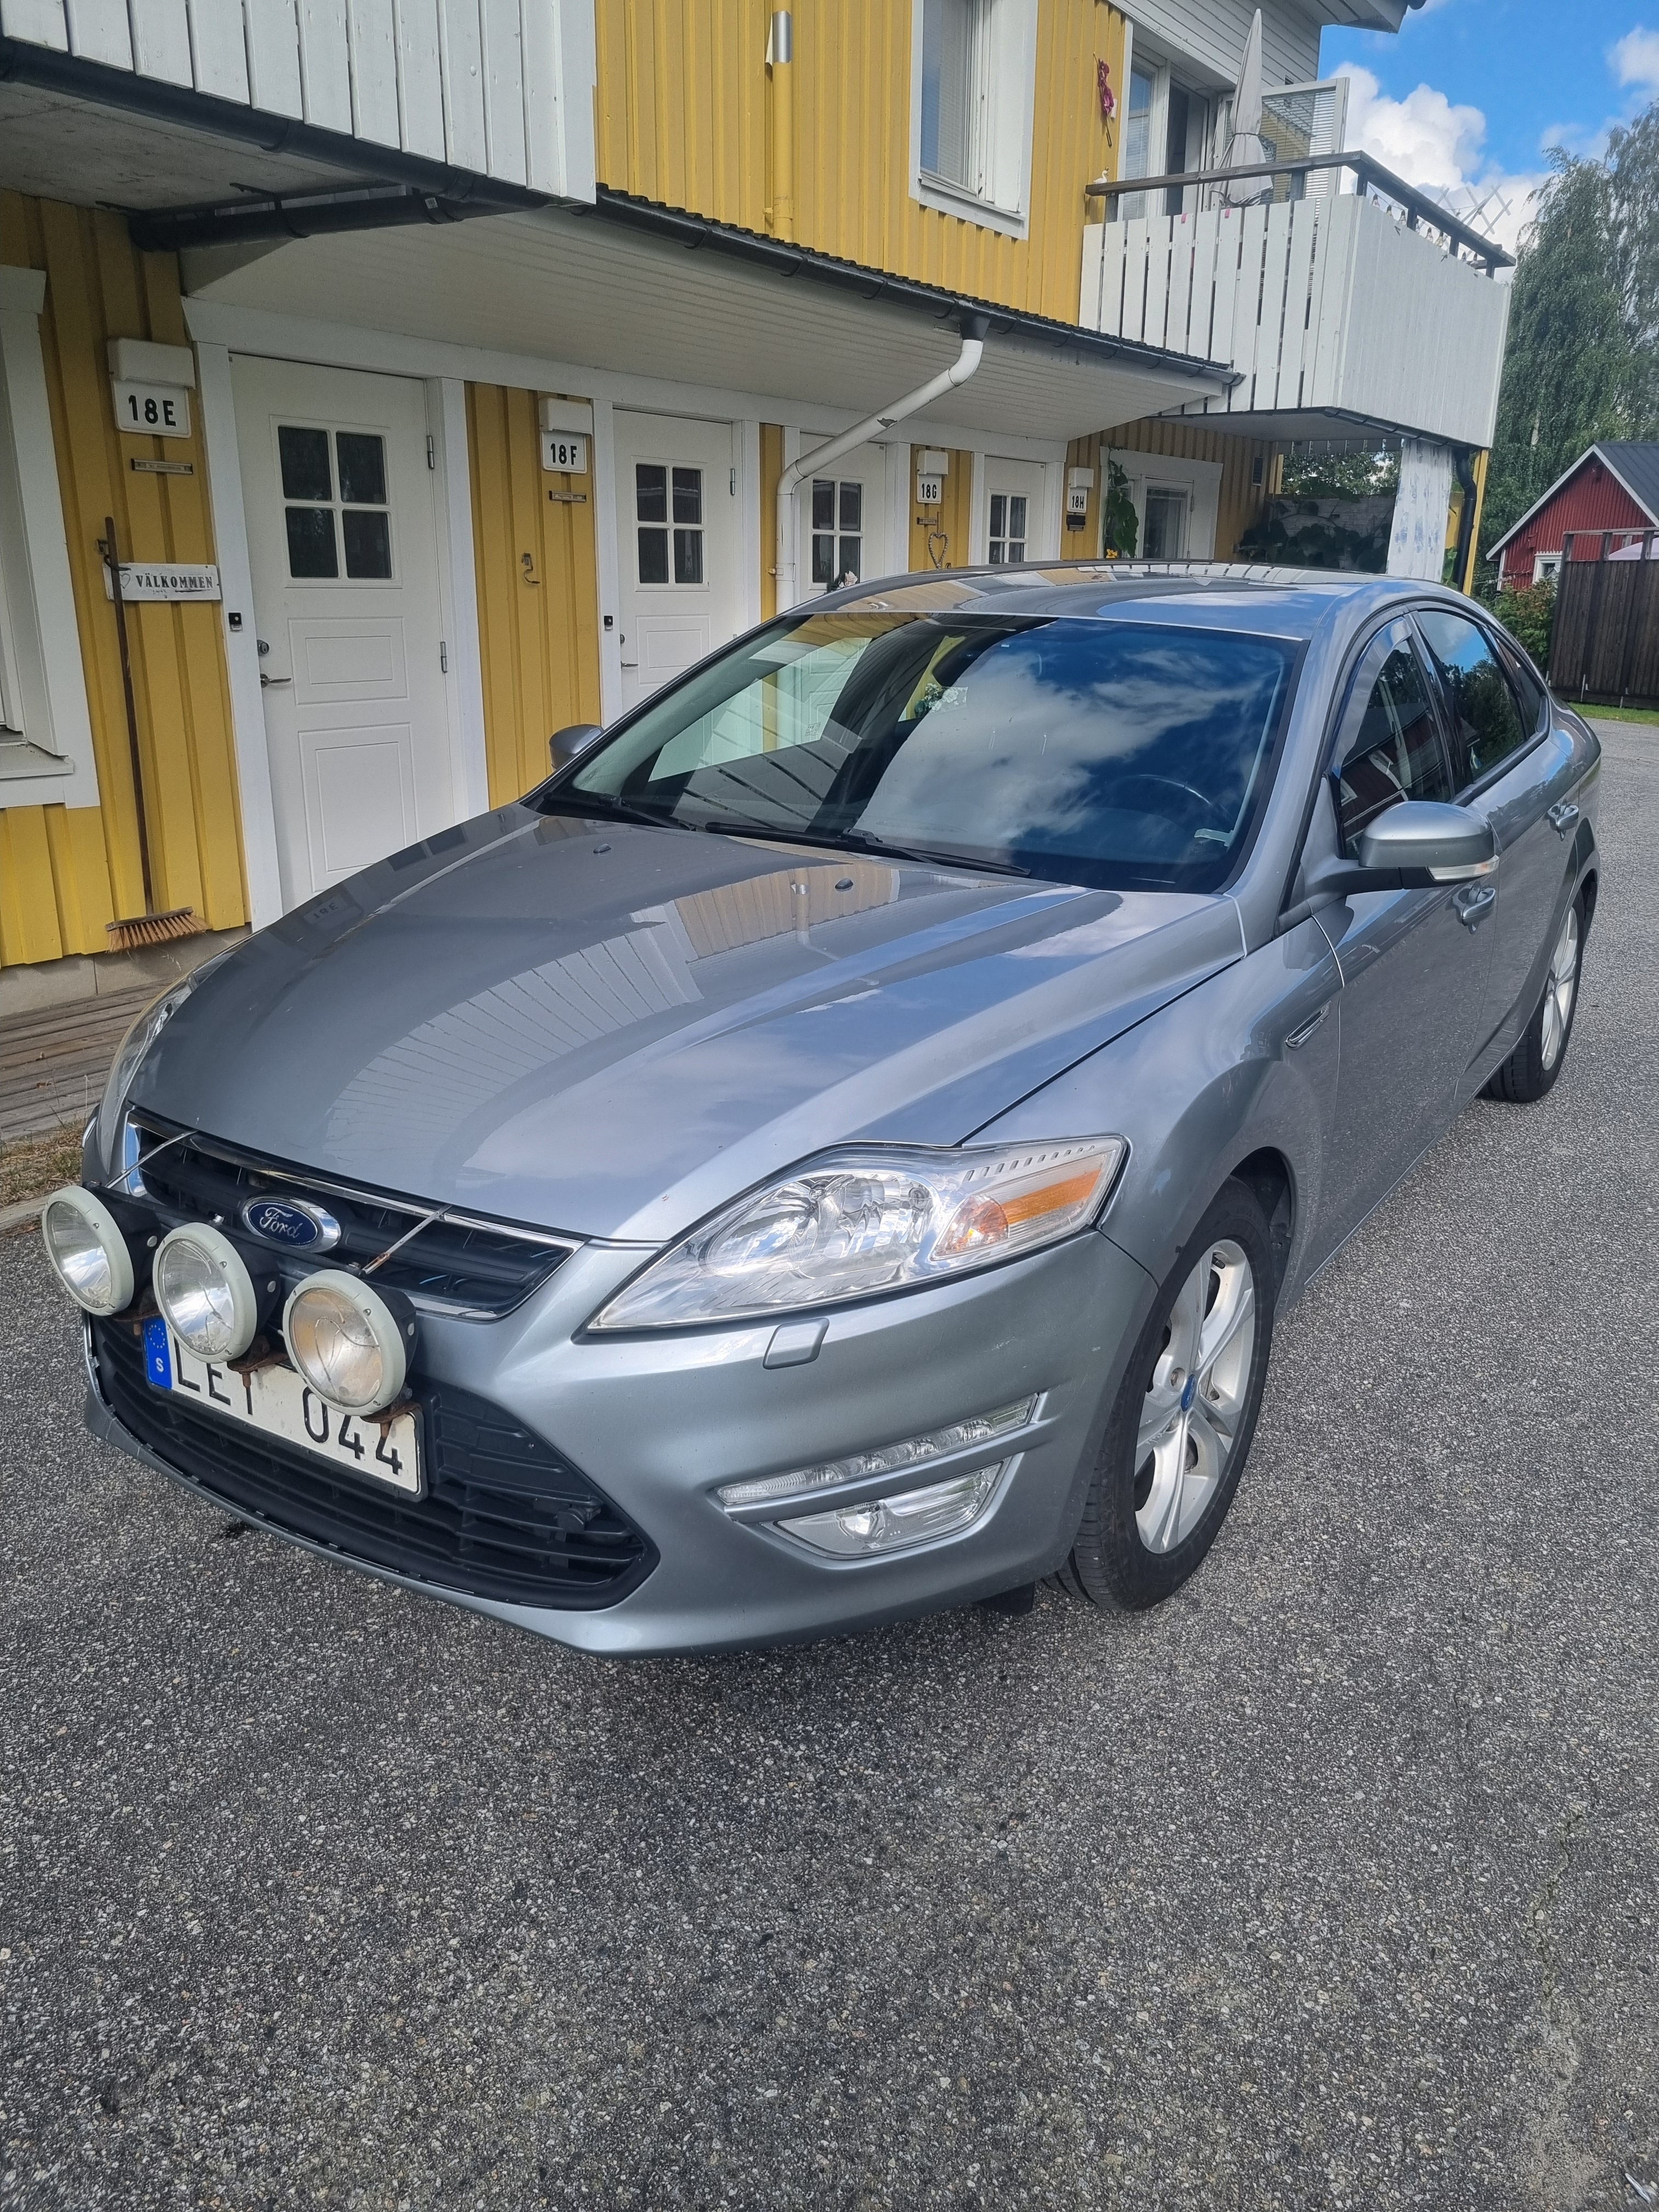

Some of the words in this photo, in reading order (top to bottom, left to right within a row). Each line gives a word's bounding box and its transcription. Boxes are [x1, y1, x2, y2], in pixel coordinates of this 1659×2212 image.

[128, 394, 177, 427] 18E
[550, 443, 577, 465] 18F
[922, 483, 937, 499] 18G
[1072, 495, 1084, 509] 18H
[136, 573, 213, 589] VÄLKOMMEN
[259, 1207, 303, 1238] Ford
[155, 1357, 164, 1372] S
[302, 1386, 403, 1476] 044
